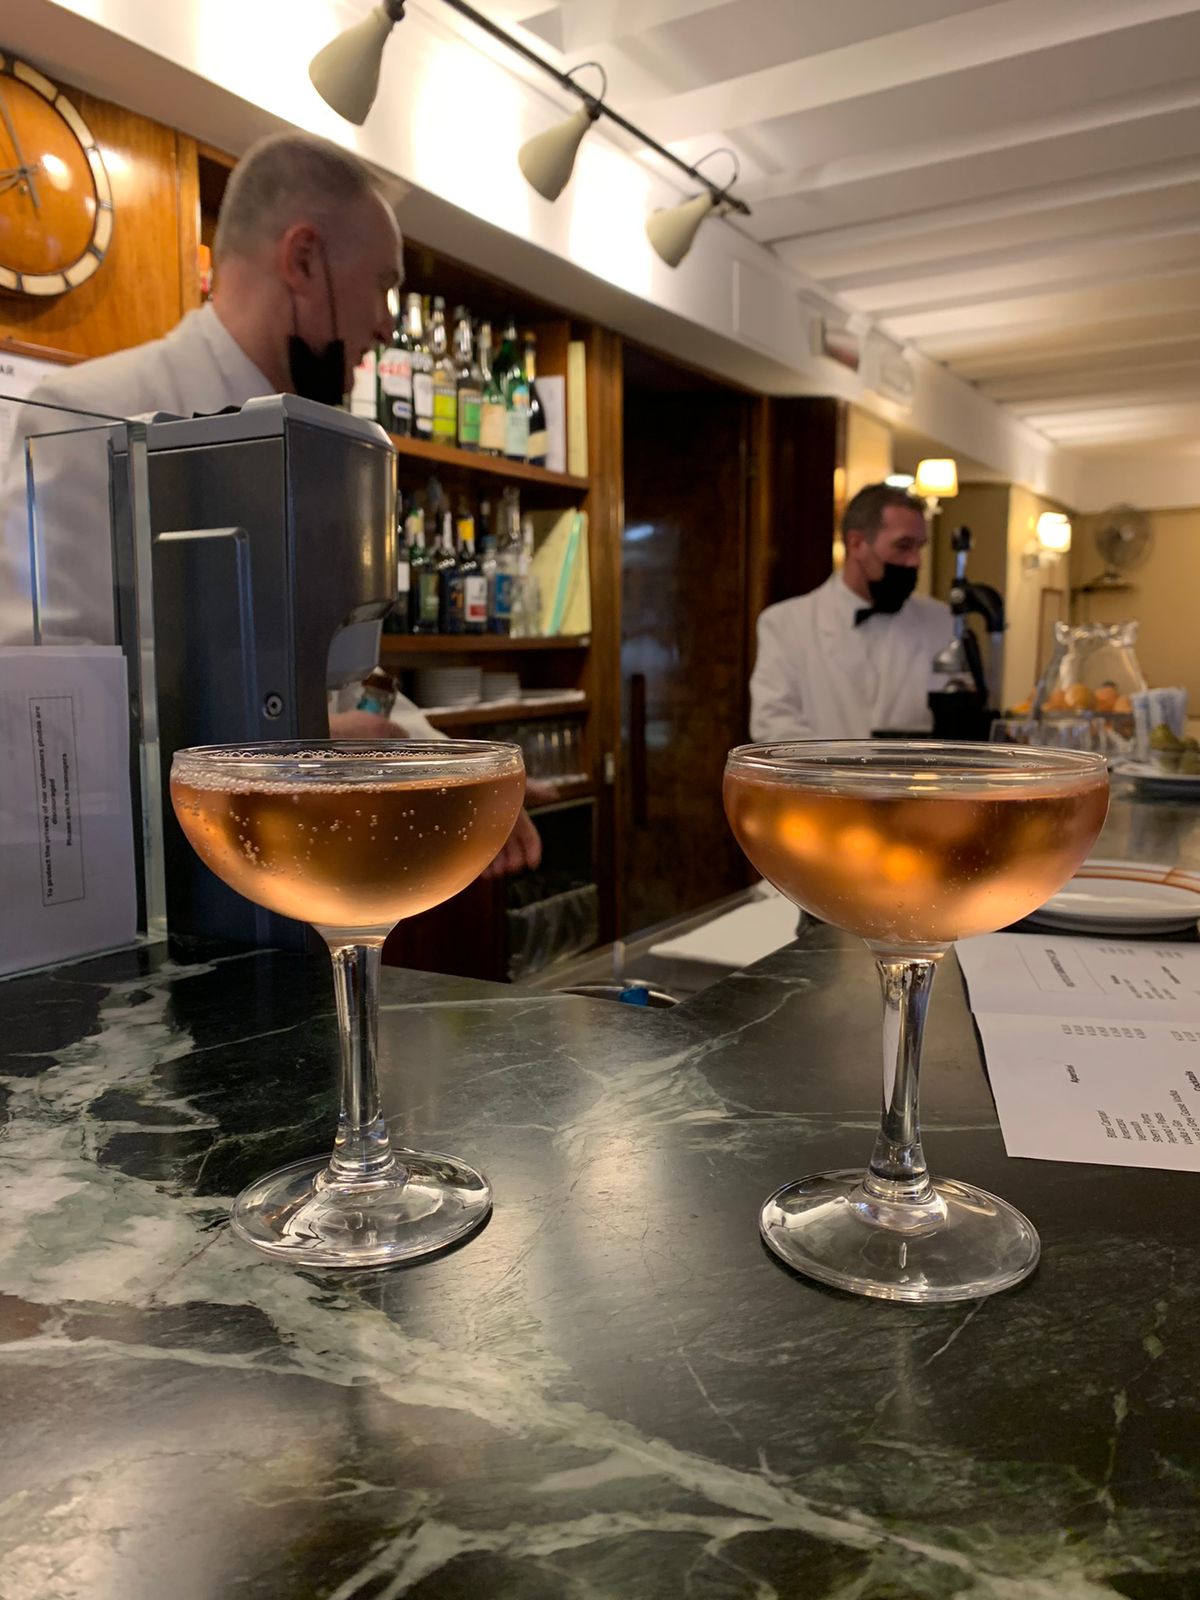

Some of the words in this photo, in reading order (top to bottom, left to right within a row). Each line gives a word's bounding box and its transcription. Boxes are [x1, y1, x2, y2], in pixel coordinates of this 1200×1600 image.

[36, 720, 45, 747] photos
[39, 748, 47, 789] customers
[42, 804, 48, 814] of
[49, 778, 58, 825] discouraged
[43, 815, 51, 843] privacy
[45, 860, 54, 887] protect
[46, 887, 53, 898] To
